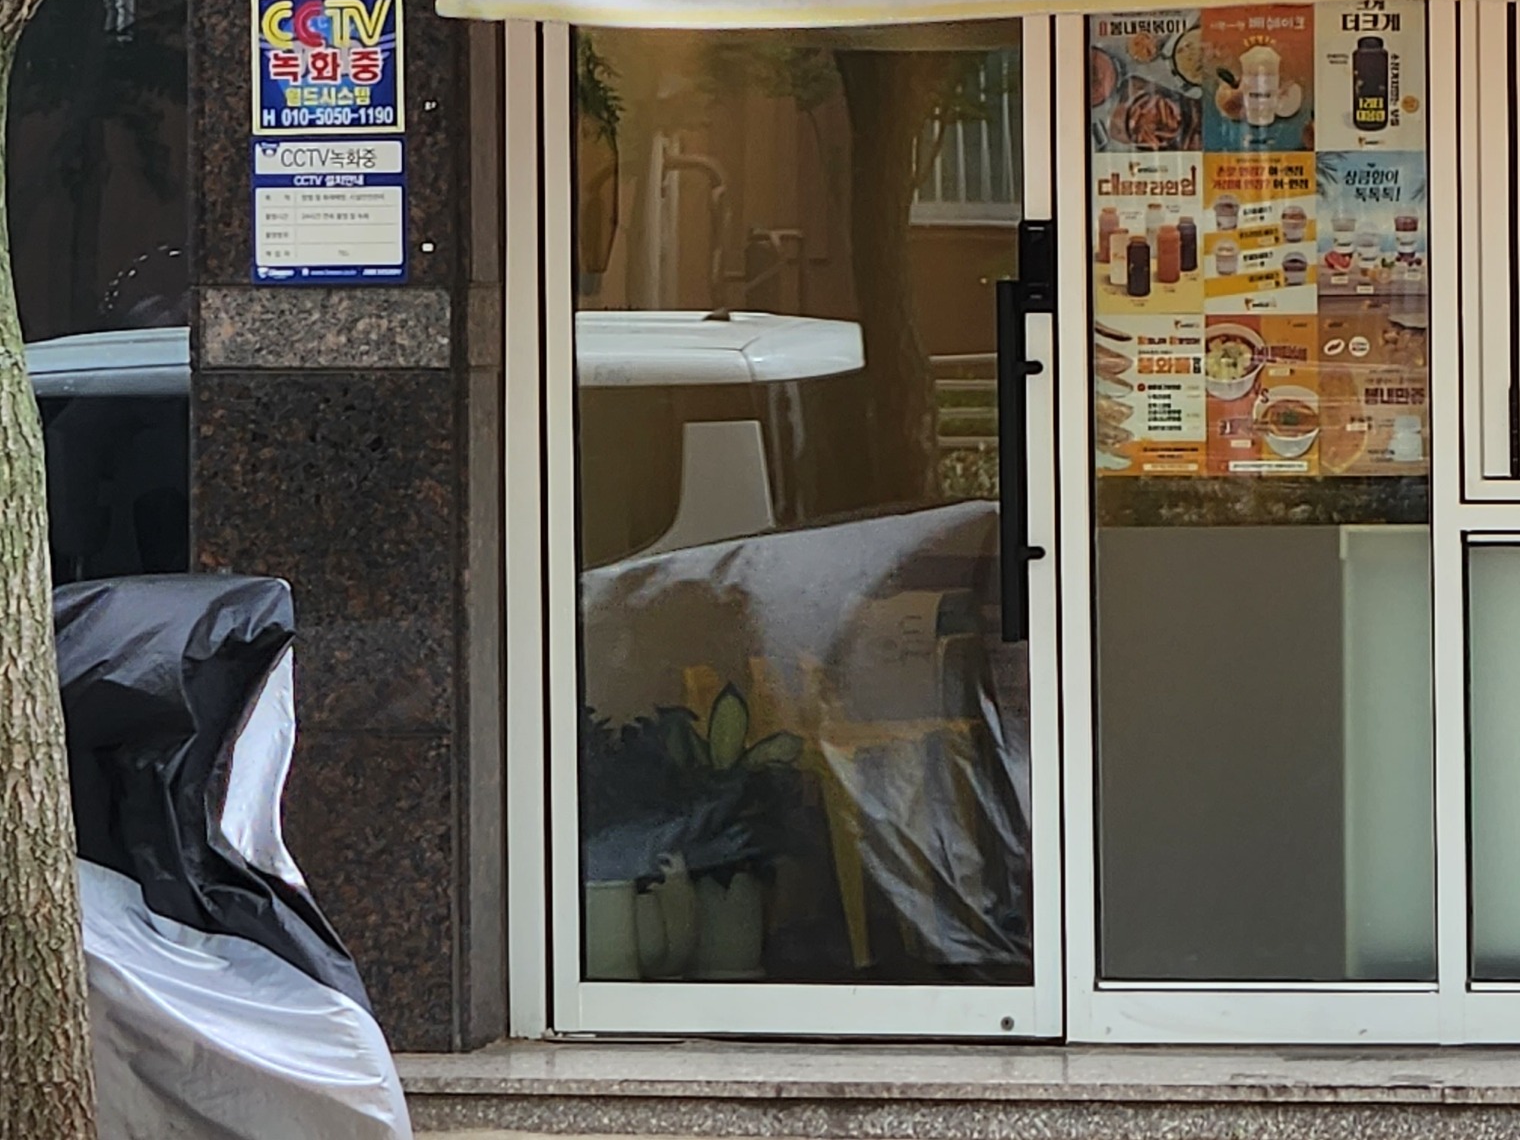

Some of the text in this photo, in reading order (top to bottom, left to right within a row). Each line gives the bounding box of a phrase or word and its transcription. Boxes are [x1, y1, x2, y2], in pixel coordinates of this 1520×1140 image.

[263, 106, 394, 127] H 010-5050-1190
[293, 175, 323, 186] CCTV
